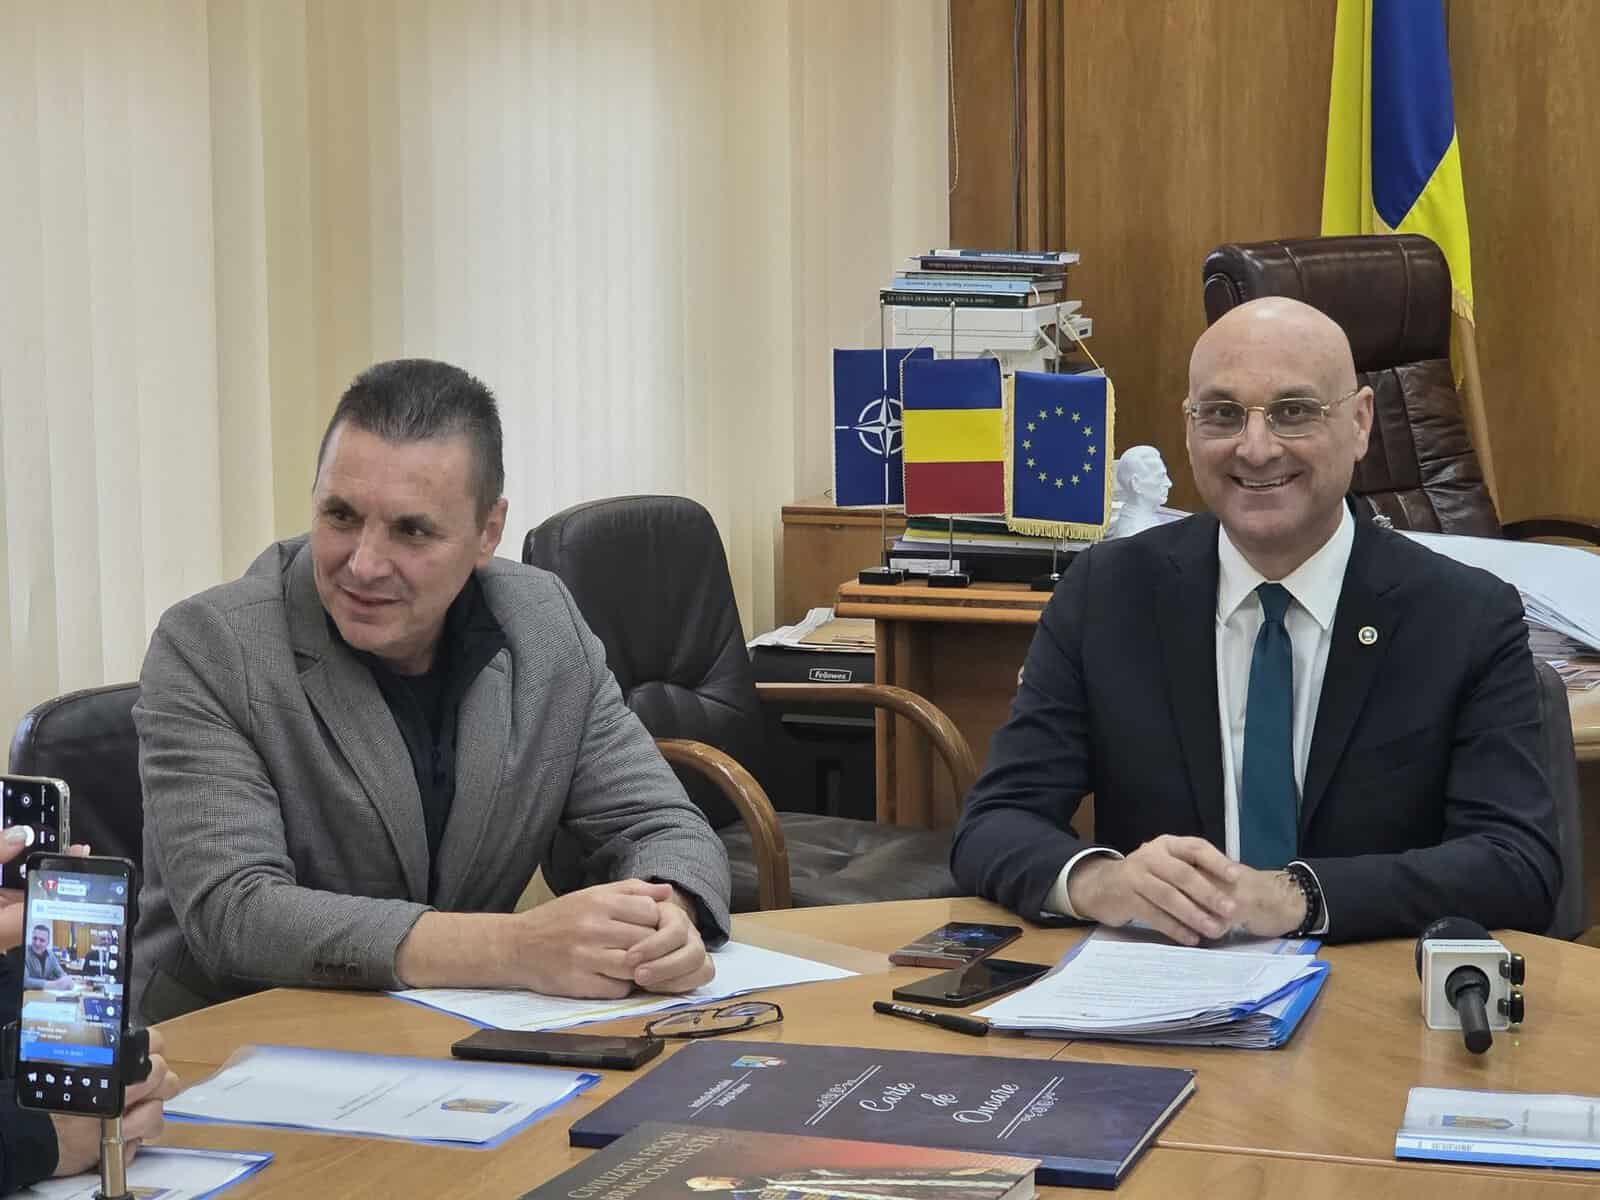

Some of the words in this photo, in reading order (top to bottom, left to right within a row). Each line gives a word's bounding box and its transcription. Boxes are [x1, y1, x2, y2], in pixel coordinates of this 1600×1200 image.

[814, 670, 846, 680] Fellowes
[859, 1081, 916, 1113] Carte
[920, 1092, 961, 1108] de
[952, 1082, 1021, 1125] Onoare
